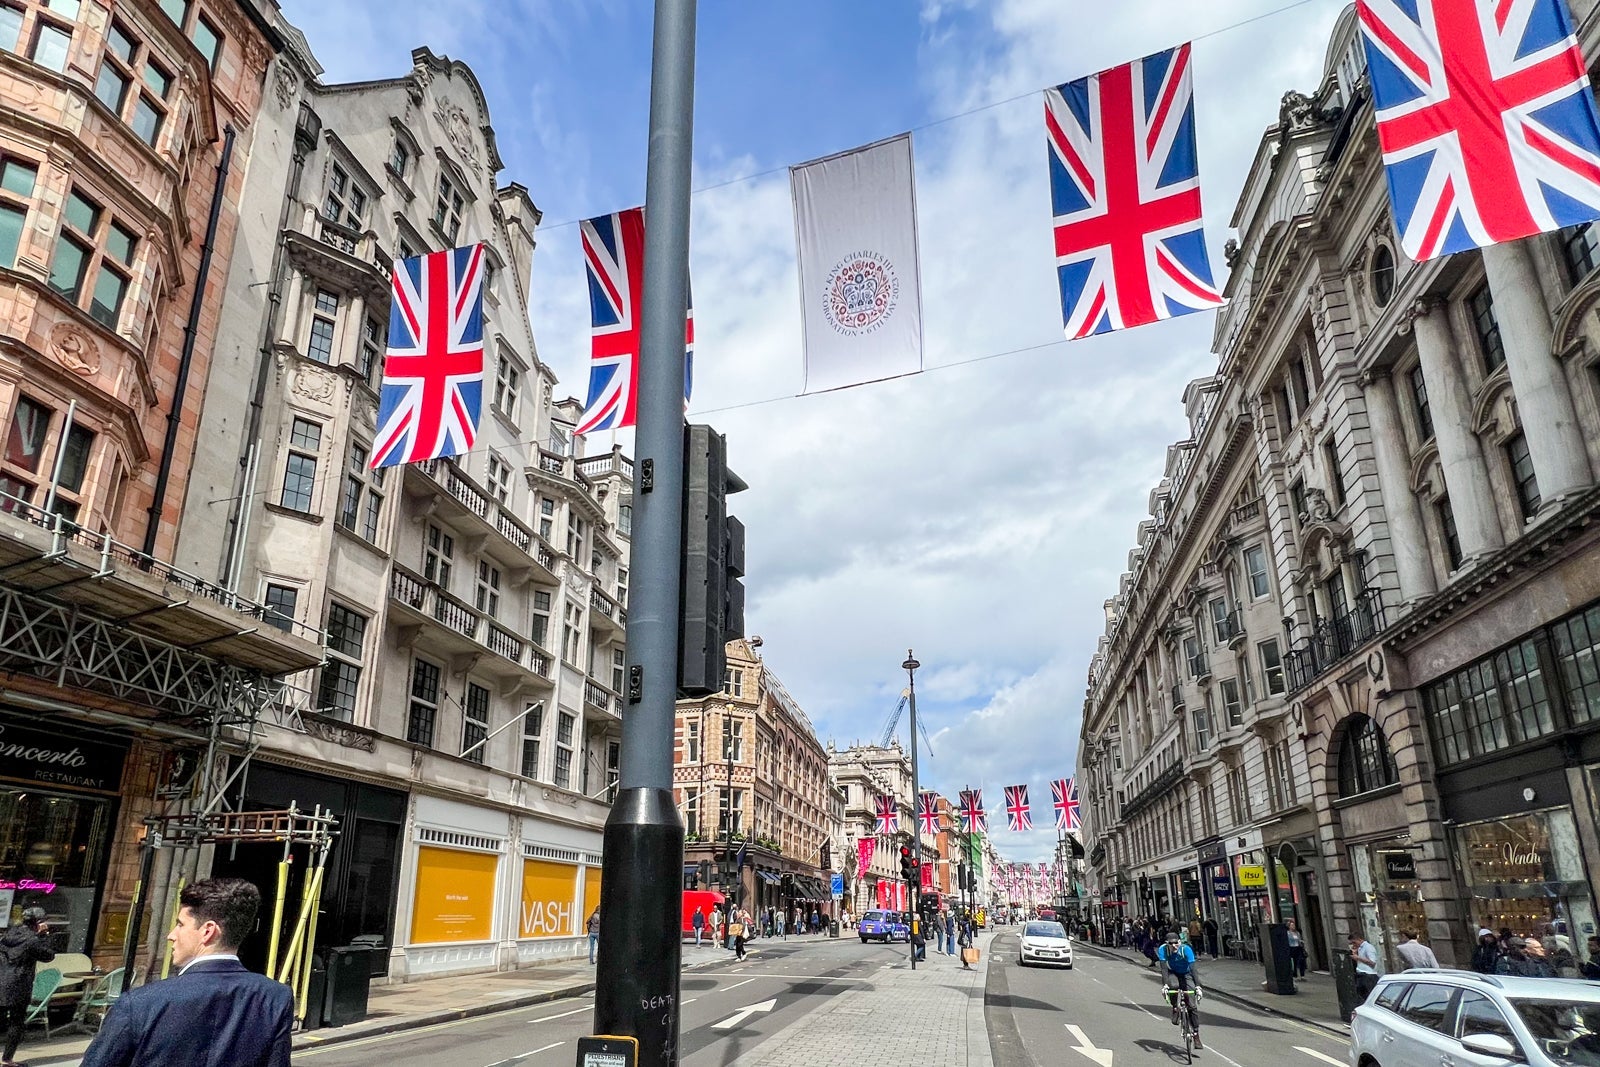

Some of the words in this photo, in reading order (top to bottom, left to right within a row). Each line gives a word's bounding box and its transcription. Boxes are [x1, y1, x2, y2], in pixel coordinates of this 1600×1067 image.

[826, 263, 843, 284] KING
[844, 250, 884, 264] CHARLES
[883, 259, 893, 271] III
[822, 294, 858, 337] CORONATION
[866, 319, 884, 334] 6TH
[882, 301, 896, 319] MAY
[0, 725, 87, 767] oncerto
[35, 770, 104, 788] RESTAURANT
[1244, 871, 1260, 879] itsu
[1388, 861, 1412, 872] Venchi
[522, 901, 574, 934] VASHI
[587, 1053, 624, 1061] PEDESTRIANS
